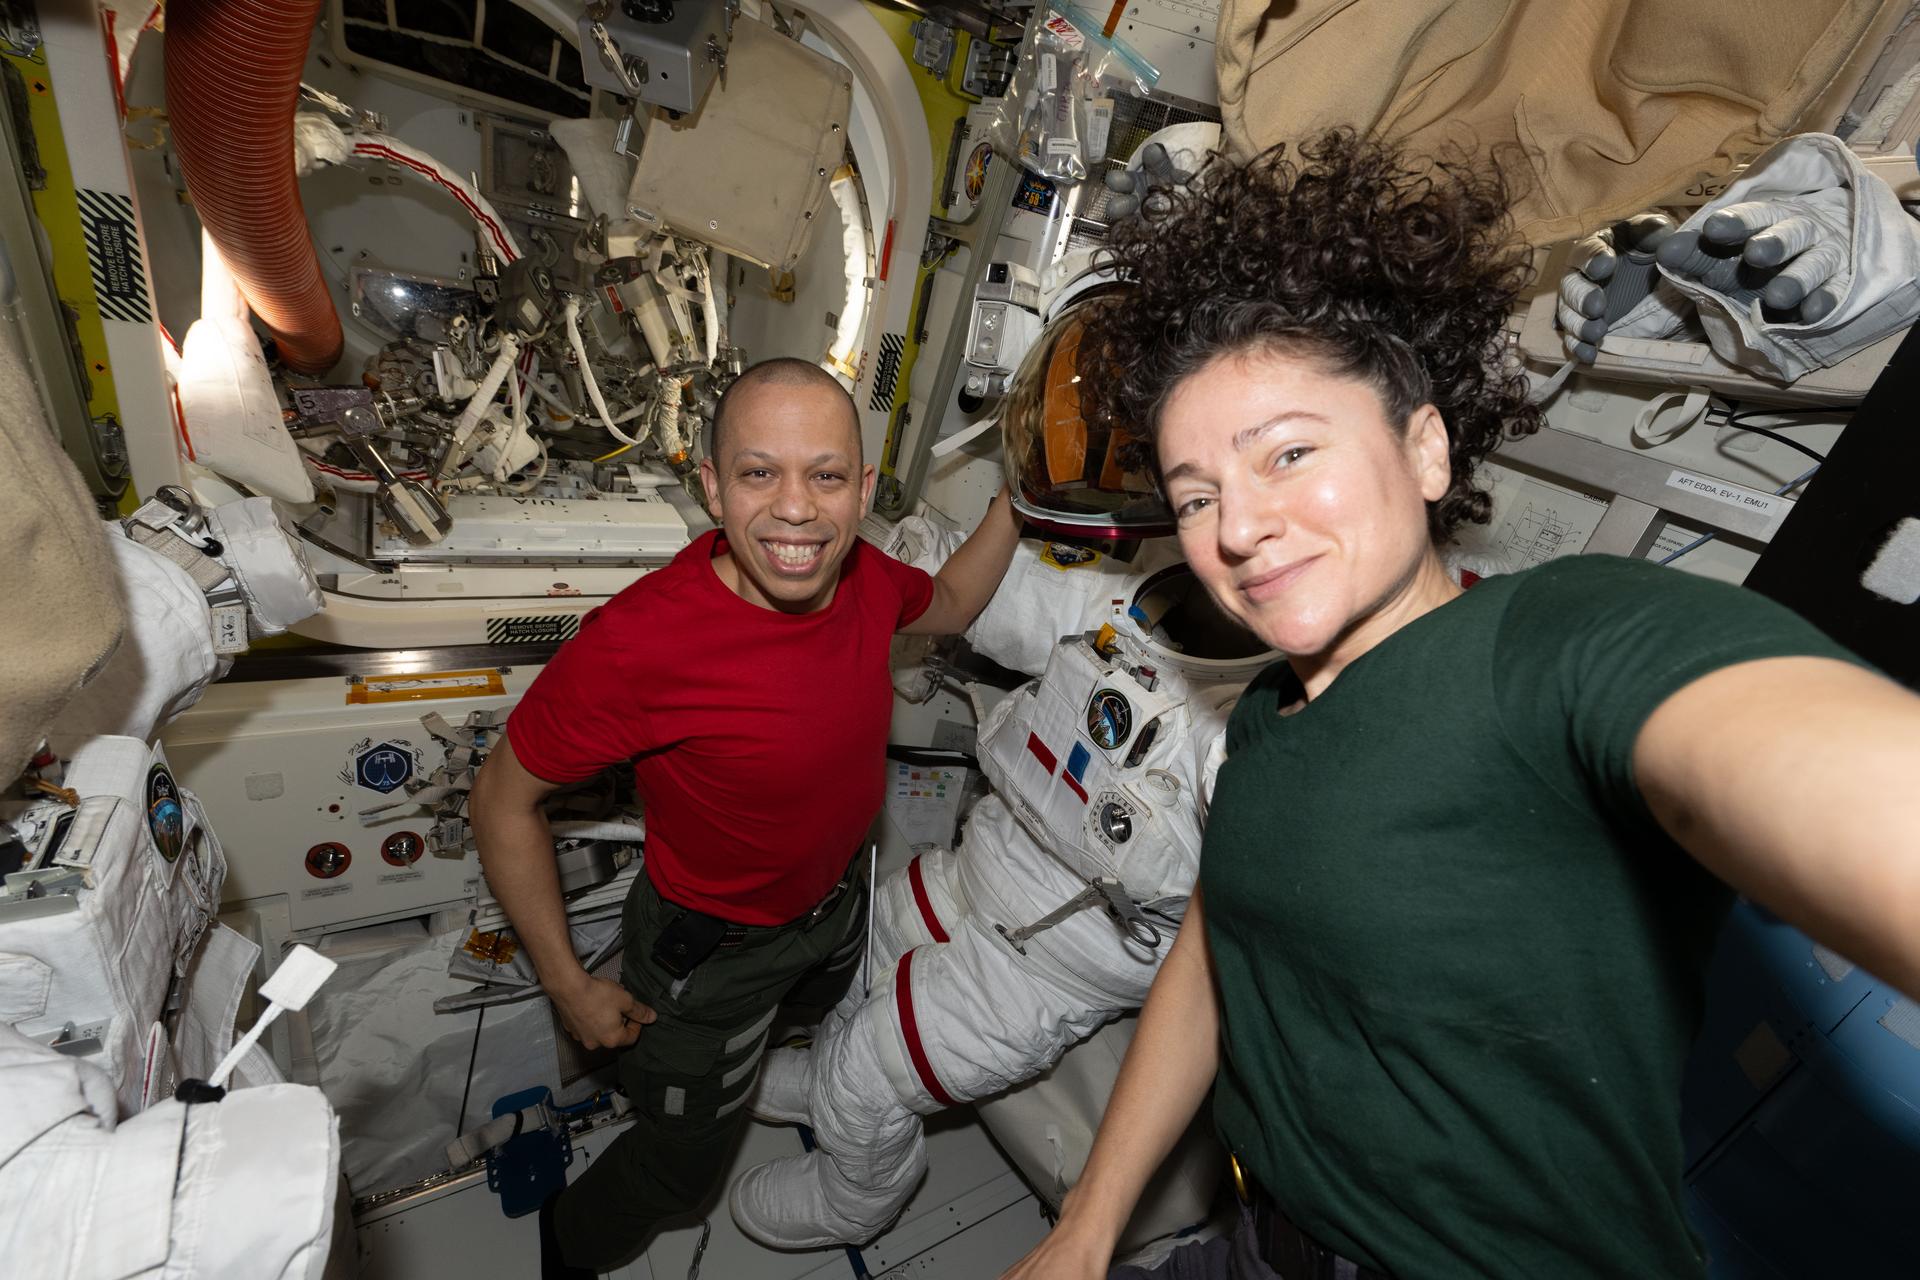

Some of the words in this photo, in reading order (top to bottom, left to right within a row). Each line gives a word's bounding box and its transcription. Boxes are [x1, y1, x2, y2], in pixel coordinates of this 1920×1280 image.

[1685, 184, 1727, 196] JE
[100, 223, 114, 257] BEFORE
[110, 225, 125, 265] CLOSURE
[106, 258, 120, 292] REMOVE
[119, 265, 130, 293] HATCH
[299, 394, 316, 409] 5
[1678, 477, 1693, 487] AFT
[1695, 482, 1718, 495] EDDA,
[1719, 490, 1741, 503] EV-1,
[1743, 497, 1769, 509] EMU1
